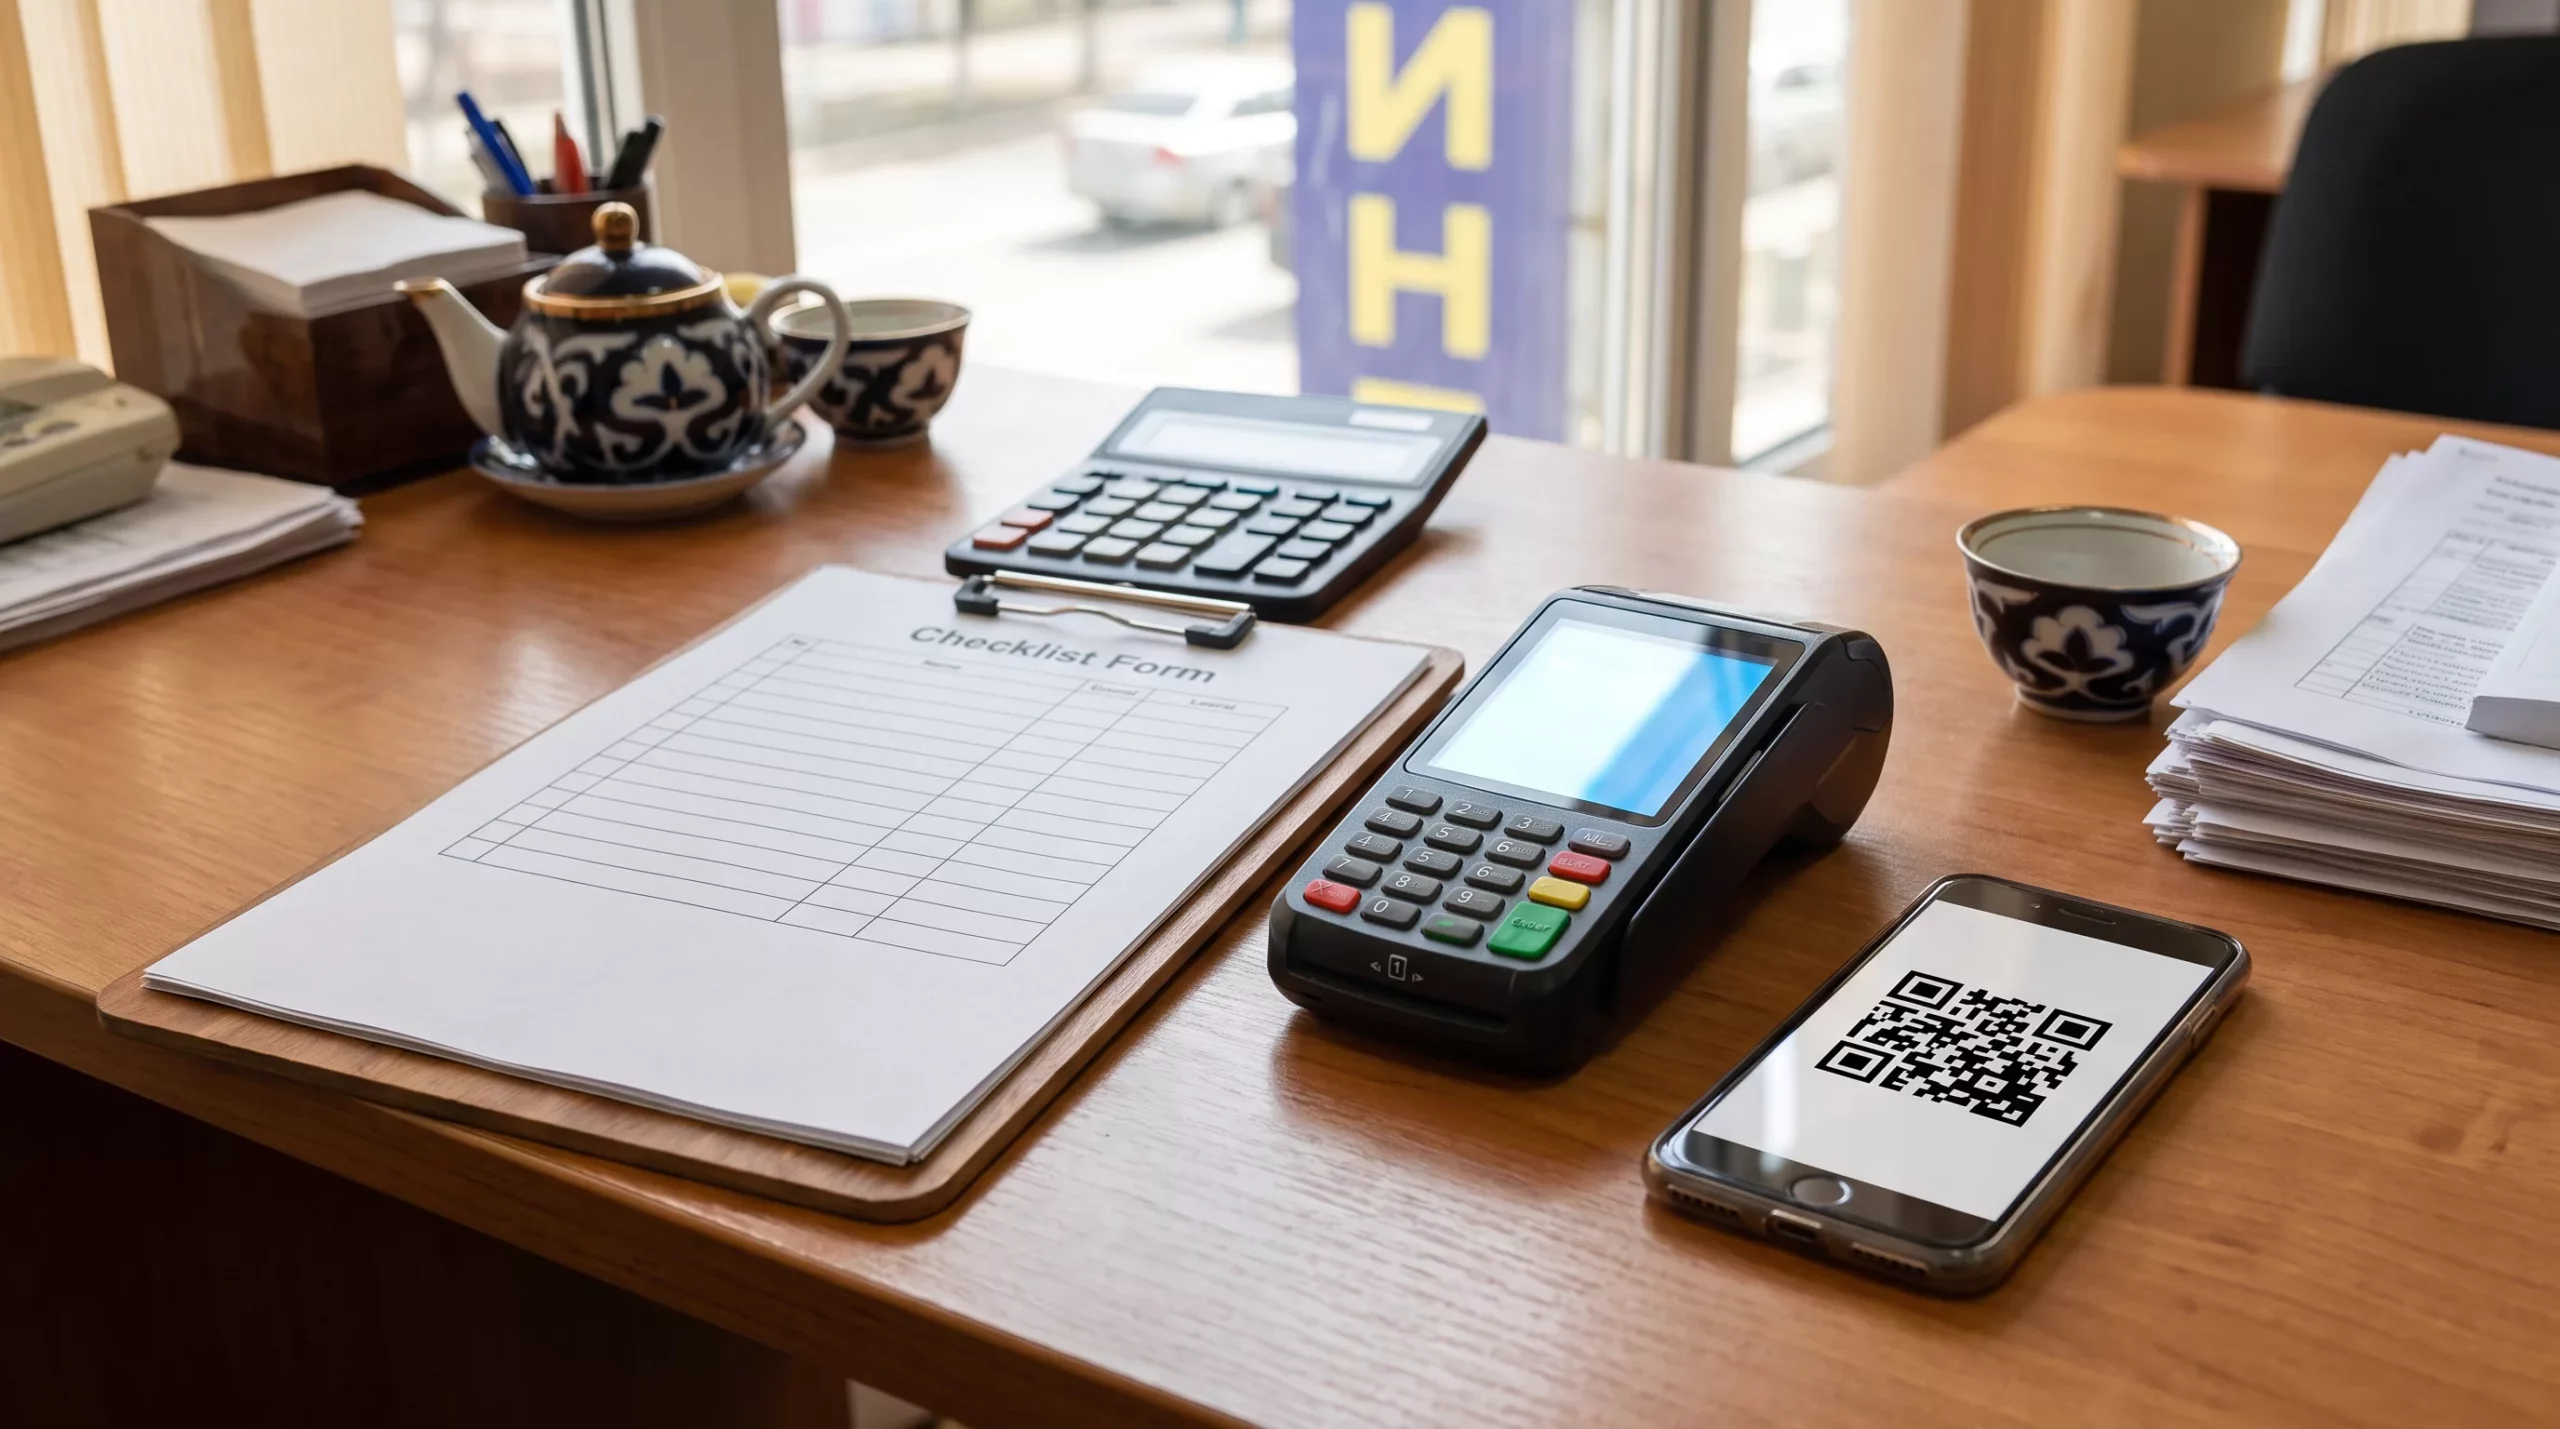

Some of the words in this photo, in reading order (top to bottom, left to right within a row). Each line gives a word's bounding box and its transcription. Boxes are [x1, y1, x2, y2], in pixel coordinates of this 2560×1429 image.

[1347, 1, 1493, 414] ИН
[910, 625, 1098, 667] Checklist
[1105, 652, 1217, 684] Form
[1404, 789, 1414, 799] 1
[1455, 803, 1471, 814] 2
[1376, 812, 1391, 822] 4
[1516, 817, 1531, 829] 3
[1435, 827, 1453, 838] 5
[1357, 835, 1372, 846] 4
[1496, 840, 1513, 852] 6
[1416, 851, 1434, 862] 5
[1336, 858, 1351, 869] 7
[1476, 865, 1493, 877] 6
[1395, 875, 1411, 887] 8
[1457, 890, 1473, 903] 9
[1373, 900, 1389, 913] 0
